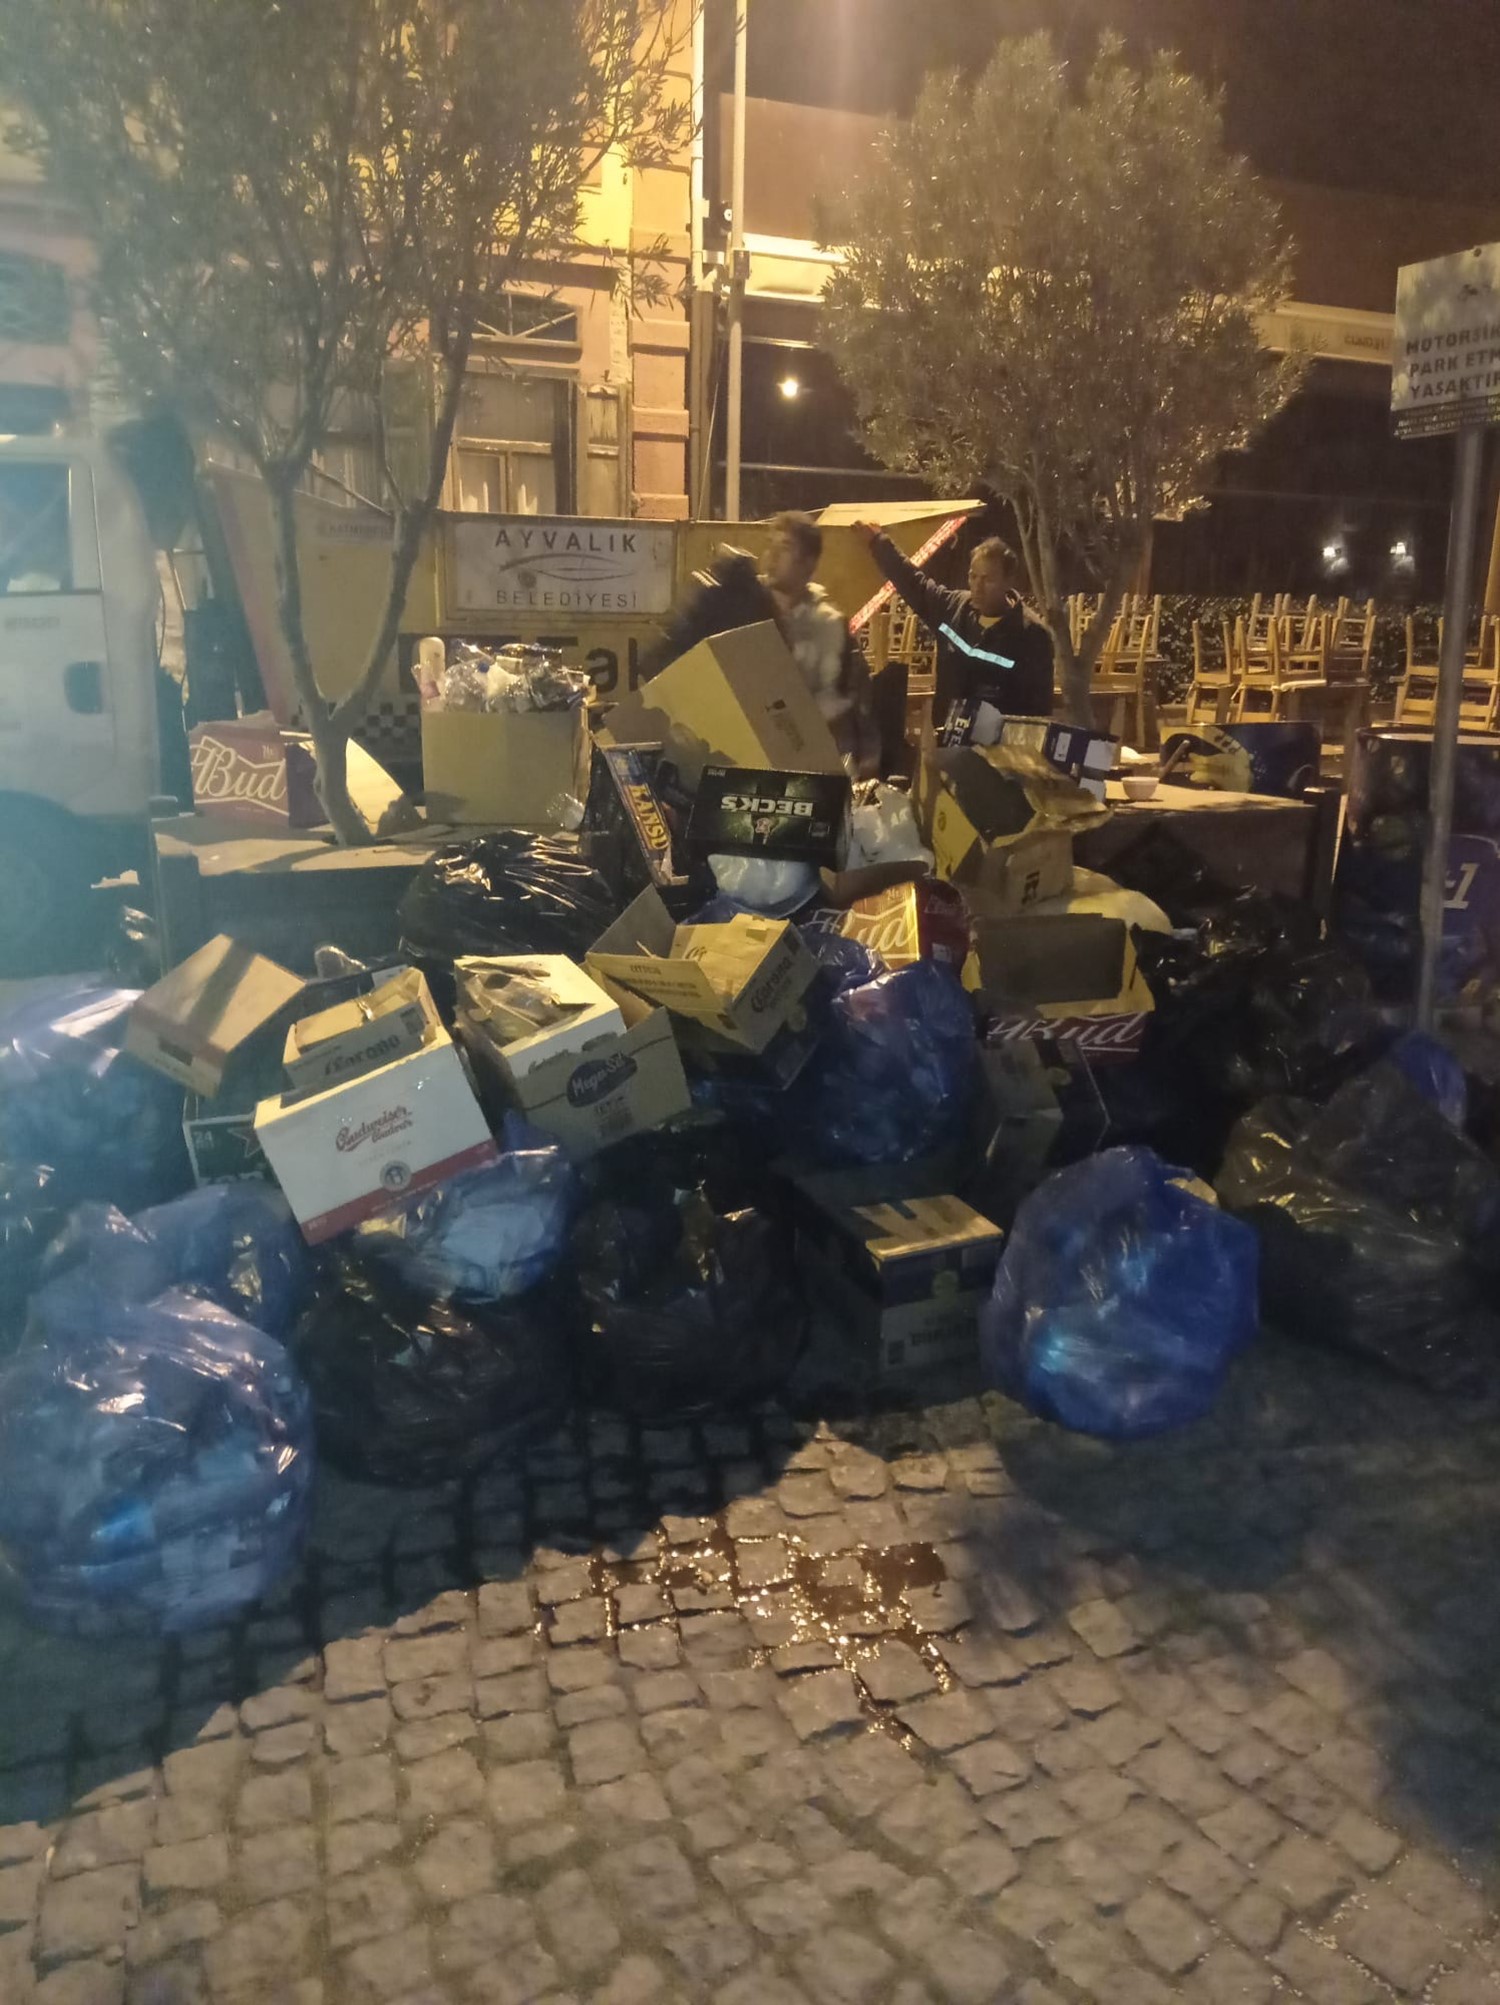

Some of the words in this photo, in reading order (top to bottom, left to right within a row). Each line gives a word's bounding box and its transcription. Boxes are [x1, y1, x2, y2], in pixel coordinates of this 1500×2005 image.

[1410, 355, 1459, 377] PARK
[494, 528, 637, 553] AYVALIK
[496, 589, 638, 607] BELEDİYESİ
[190, 744, 288, 800] Bud
[720, 795, 815, 818] BECK'S
